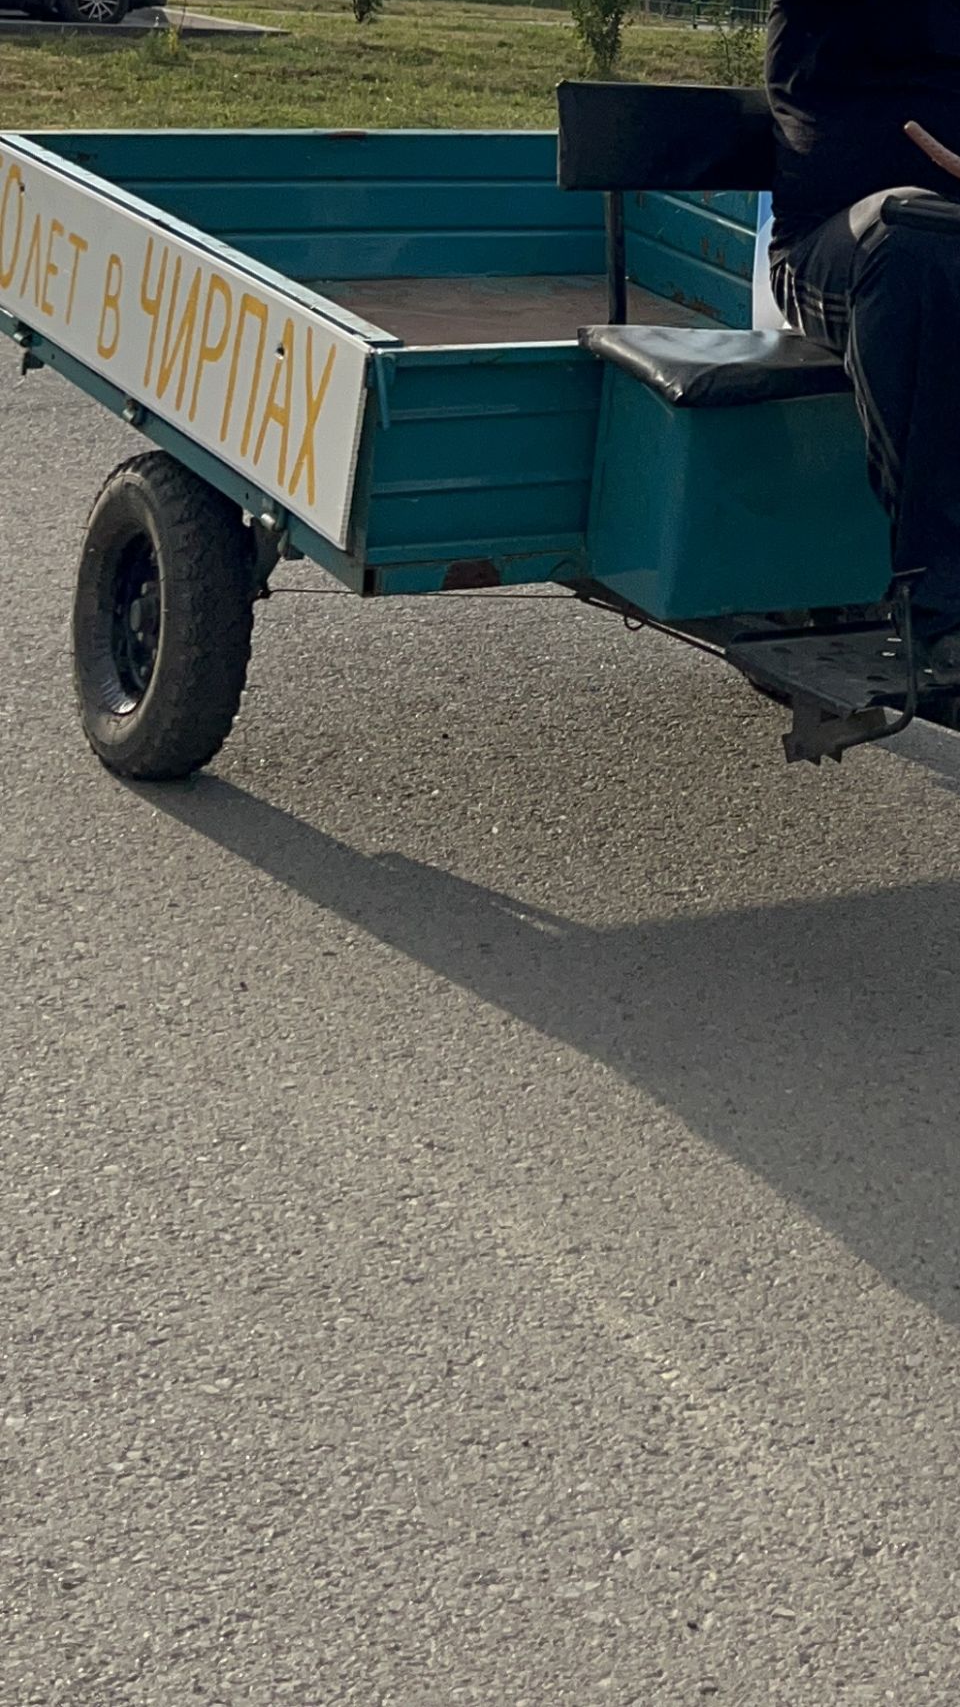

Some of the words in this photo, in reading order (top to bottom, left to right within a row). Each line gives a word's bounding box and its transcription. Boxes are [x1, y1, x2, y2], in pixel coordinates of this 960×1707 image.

[0, 156, 88, 325] ОЛЕТ
[97, 254, 123, 360] В
[140, 237, 337, 506] ЧИРПАХ
